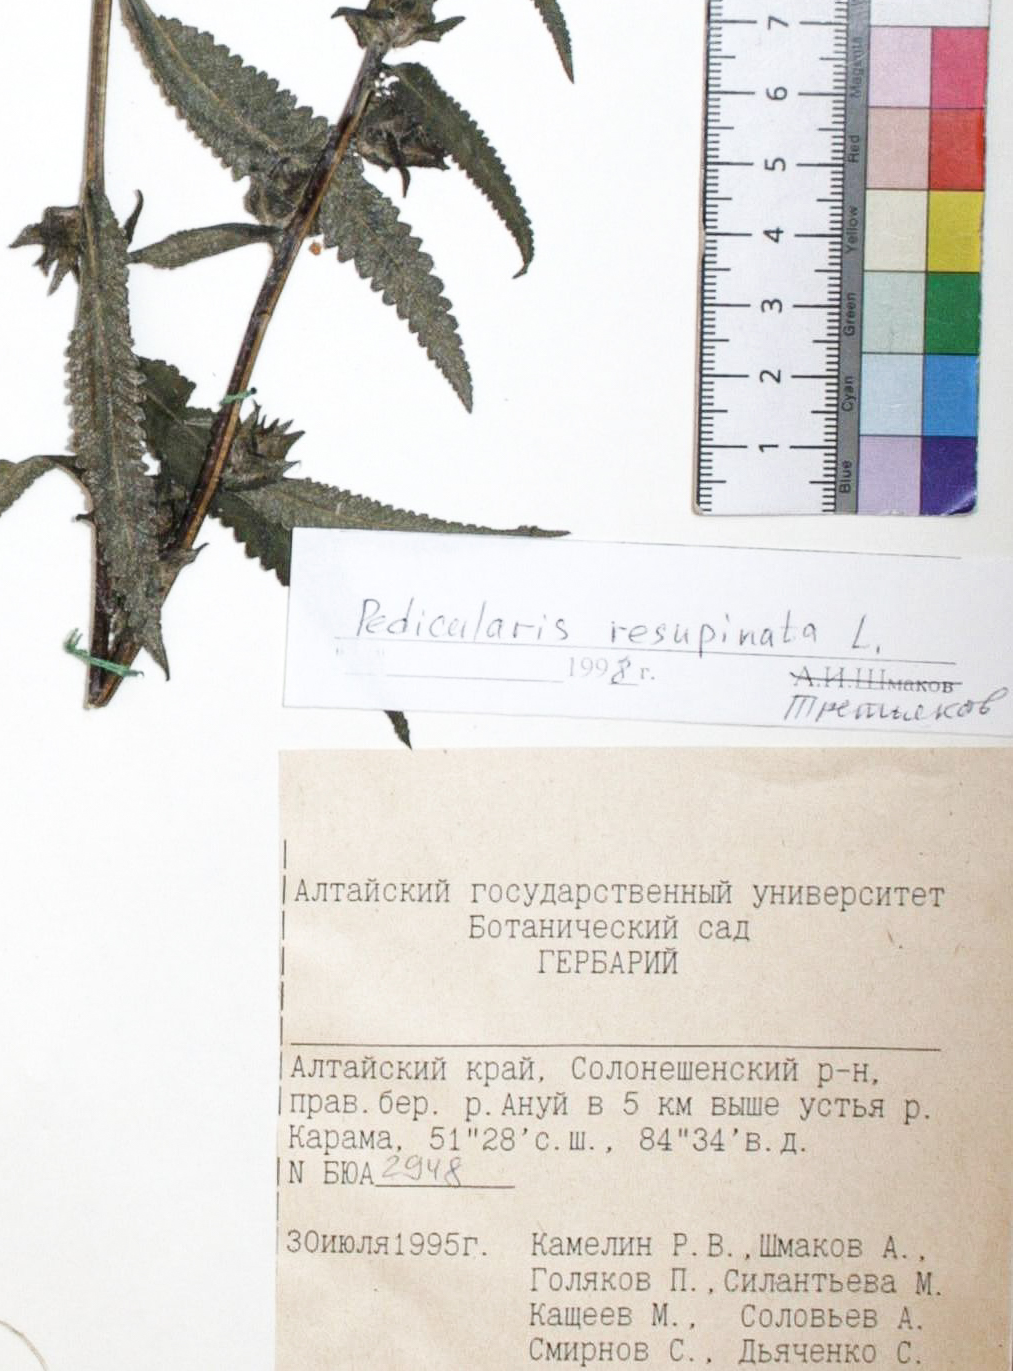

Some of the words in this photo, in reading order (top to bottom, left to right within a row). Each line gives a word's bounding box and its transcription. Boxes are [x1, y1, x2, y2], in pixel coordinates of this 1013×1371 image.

[767, 16, 789, 30] 7
[766, 86, 788, 101] 6
[764, 157, 786, 171] 5
[848, 135, 860, 164] Red
[763, 228, 784, 243] 4
[845, 205, 858, 255] Yellow
[761, 299, 783, 313] 3
[843, 292, 856, 337] Green
[759, 369, 781, 383] 2
[841, 376, 854, 412] Cyan
[758, 443, 779, 453] 1
[839, 460, 851, 494] Blue
[357, 597, 568, 641] Pedicularis
[608, 610, 818, 658] resupinata
[851, 614, 881, 654] L.
[294, 878, 451, 903] Алтайский
[471, 880, 732, 909] государственный
[752, 884, 945, 912] университет
[468, 914, 679, 941] Ботанический
[698, 919, 750, 942] сад
[537, 946, 678, 975] ГЕРБАРИЙ
[290, 1055, 447, 1081] Алтайский
[466, 1056, 545, 1087] край,
[571, 1057, 799, 1083] Солонешенский
[817, 1060, 880, 1088] р-н,
[588, 1095, 604, 1115] в
[623, 1091, 639, 1116] 5
[658, 1096, 692, 1116] км
[711, 1096, 780, 1117] выше
[799, 1096, 884, 1121] устья
[904, 1098, 932, 1125] р.
[288, 1124, 404, 1153] Карама,
[288, 1160, 304, 1185] N
[531, 1232, 653, 1257] Камелин
[530, 1267, 651, 1292] Голяков
[915, 1271, 942, 1297] М.
[529, 1302, 633, 1330] Кащеев
[740, 1304, 878, 1329] Соловьев
[897, 1306, 924, 1331] А.
[528, 1336, 649, 1367] Смирнов
[738, 1338, 877, 1365] Дьяченко
[896, 1340, 922, 1365] С.
